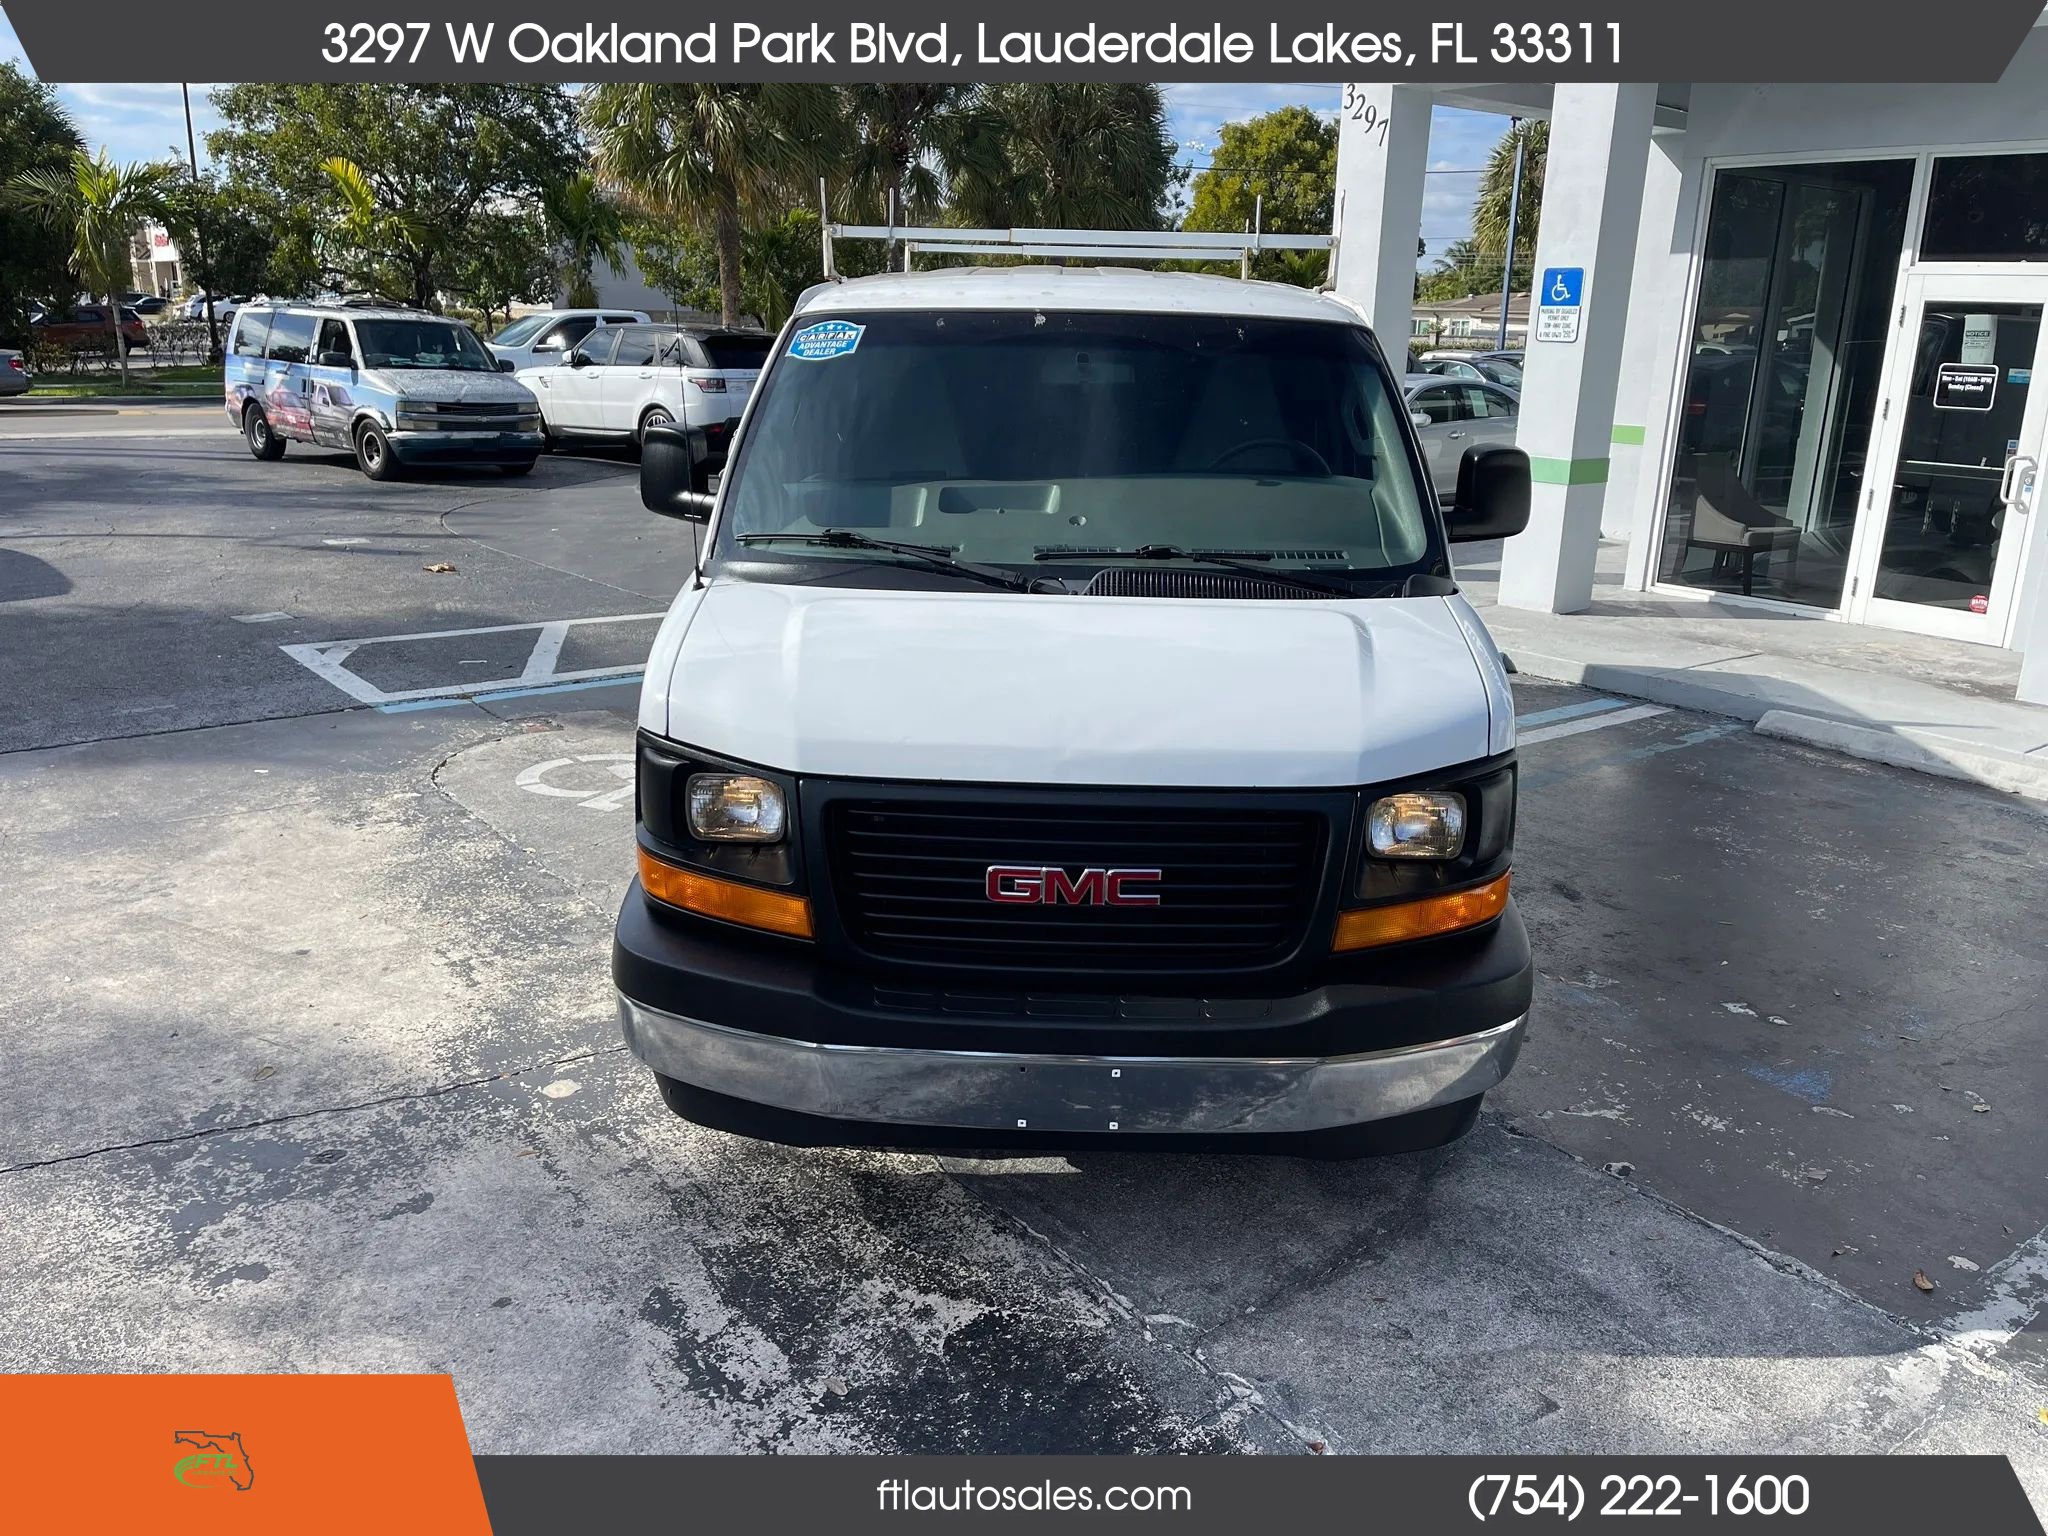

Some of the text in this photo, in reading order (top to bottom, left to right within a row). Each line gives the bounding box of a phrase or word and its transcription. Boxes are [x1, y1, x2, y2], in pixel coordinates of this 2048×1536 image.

[1344, 83, 1389, 147] 3297
[800, 332, 854, 341] CARFAX
[798, 340, 848, 350] ADVANTAGE
[803, 348, 836, 356] DEALER
[1948, 383, 1964, 391] Sunday
[986, 865, 1162, 906] GMC
